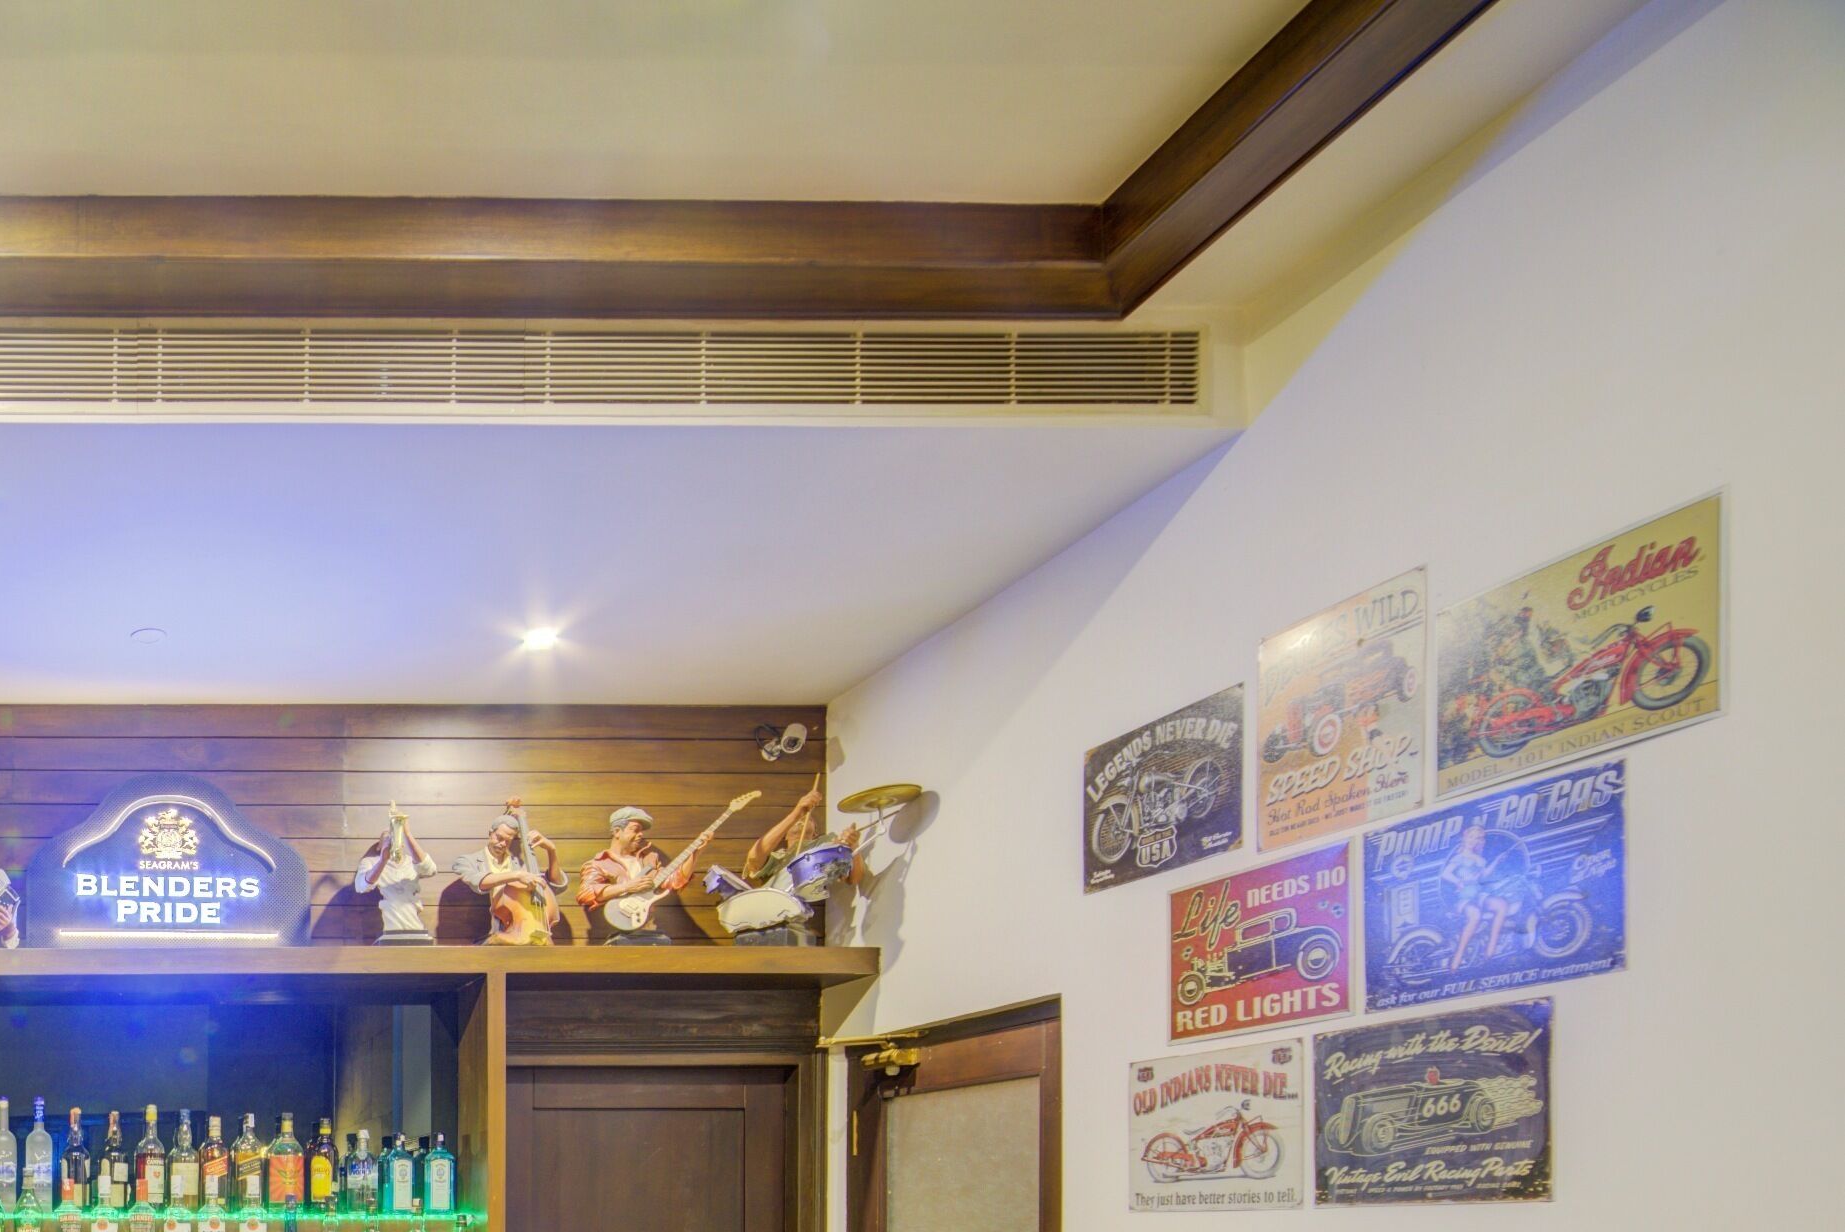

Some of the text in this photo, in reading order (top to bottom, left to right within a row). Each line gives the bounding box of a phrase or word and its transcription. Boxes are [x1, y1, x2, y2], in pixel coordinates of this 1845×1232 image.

[1567, 536, 1701, 610] Indian
[1574, 566, 1699, 622] MOTOCYCLES
[1354, 589, 1419, 635] WILD
[1086, 717, 1238, 802] LEGENDS NEVER DIE
[1447, 762, 1502, 789] MODEL
[1559, 722, 1626, 754] INDIAN
[1632, 697, 1705, 730] SCOUT
[1266, 735, 1412, 806] SPEED SHOP
[1267, 774, 1410, 826] Hot Rod Spoken Here
[1372, 815, 1464, 872] PUMP
[1496, 792, 1540, 830] GO
[1546, 769, 1622, 824] GAS
[139, 860, 200, 870] SEAGRAM'S
[1140, 839, 1172, 865] USA
[76, 873, 261, 898] BLENDERS
[116, 900, 221, 923] PRIDE
[1173, 880, 1241, 949] Life
[1176, 982, 1341, 1032] RED LIGHTS
[1376, 957, 1614, 1008] ask for our FULL SERVICE treatment
[1324, 1050, 1384, 1081] Racing
[1385, 1032, 1426, 1060] with
[1428, 1030, 1459, 1053] the
[1133, 1088, 1157, 1116] OLD
[1160, 1064, 1212, 1109] INDIANS
[1214, 1063, 1259, 1097] NEVER
[1422, 1093, 1461, 1118] 666
[1325, 1165, 1382, 1187] Vintage
[1383, 1161, 1422, 1183] Evil
[1423, 1160, 1481, 1187] Racing
[1481, 1157, 1535, 1178] Parts
[1424, 1139, 1534, 1155] EQUIPPED WITH GENUINE
[1135, 1187, 1296, 1208] They just have better stories to tell.
